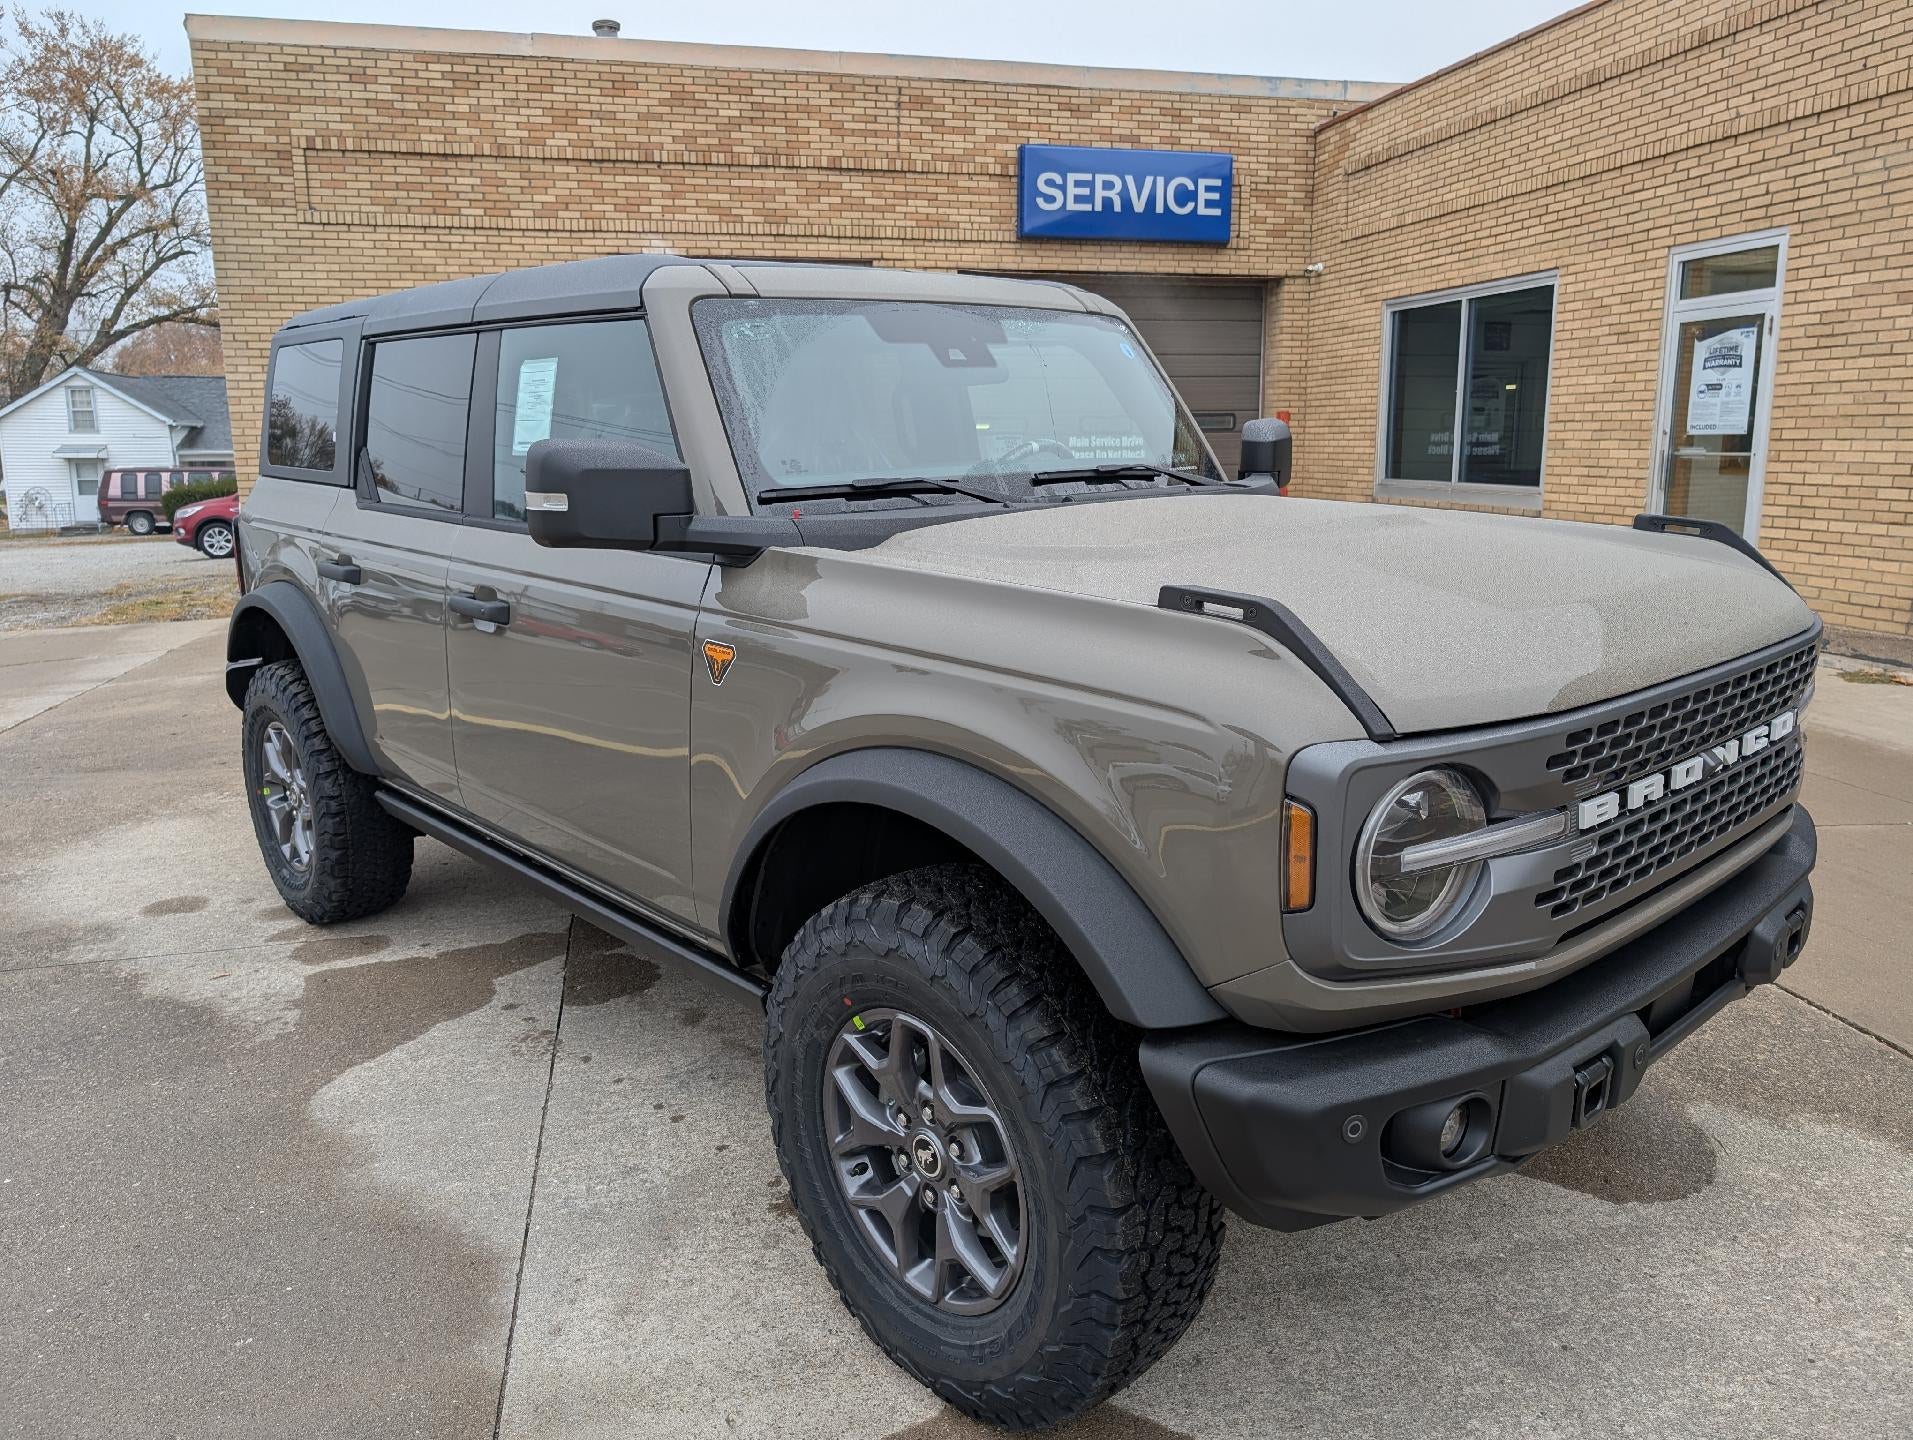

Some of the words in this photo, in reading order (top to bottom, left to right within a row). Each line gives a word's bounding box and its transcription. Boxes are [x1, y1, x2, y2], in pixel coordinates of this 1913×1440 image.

[1036, 172, 1222, 216] SERVICE
[1709, 345, 1739, 355] LIFETIME
[1705, 358, 1741, 369] WARRANTY
[1689, 423, 1717, 431] INCLUDED
[1069, 436, 1089, 447] Main
[1090, 435, 1121, 447] Service
[1122, 436, 1144, 447] Drive
